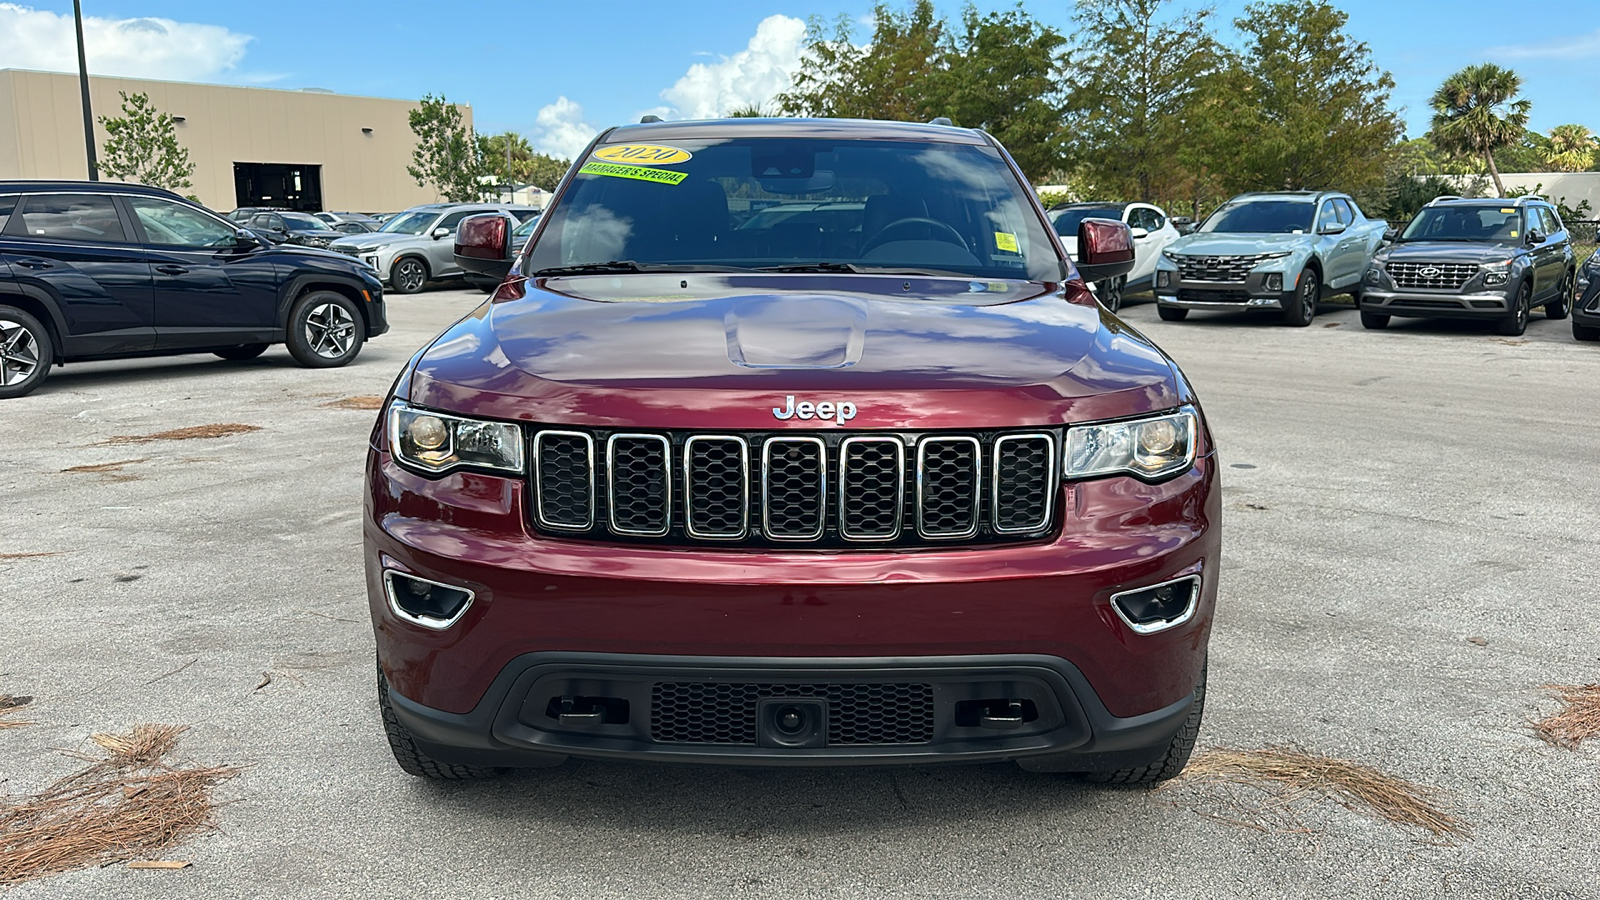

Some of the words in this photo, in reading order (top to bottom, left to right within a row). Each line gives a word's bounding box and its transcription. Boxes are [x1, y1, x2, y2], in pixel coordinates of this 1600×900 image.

[605, 147, 678, 160] 2020
[584, 163, 639, 176] MANAGER'S
[640, 170, 683, 182] SPECIAL
[772, 395, 857, 425] Jeep
